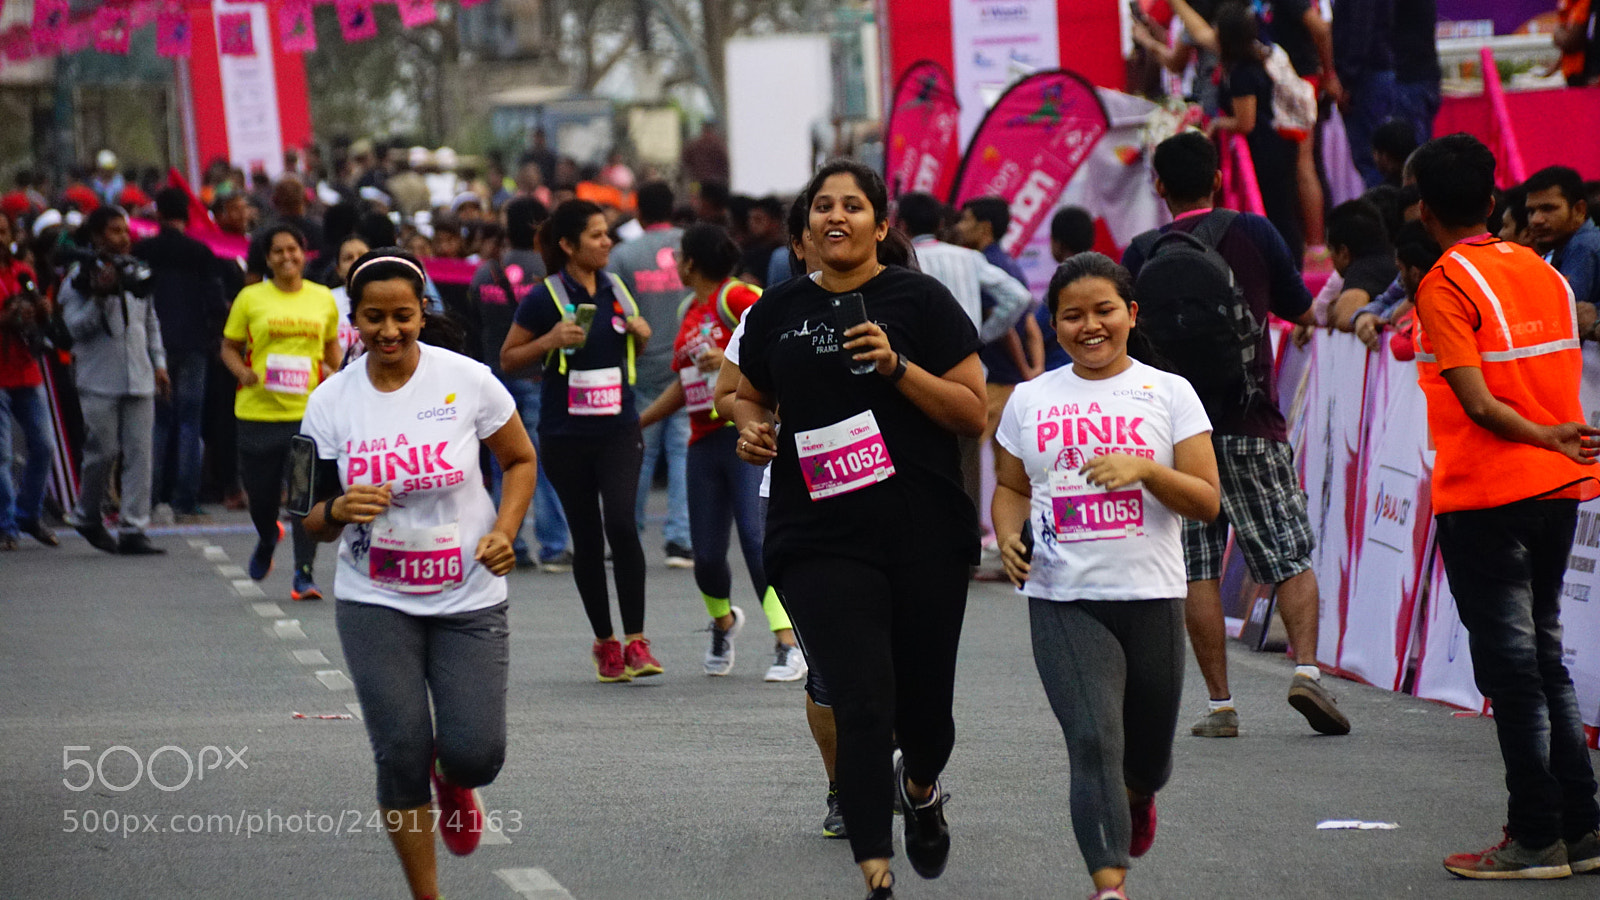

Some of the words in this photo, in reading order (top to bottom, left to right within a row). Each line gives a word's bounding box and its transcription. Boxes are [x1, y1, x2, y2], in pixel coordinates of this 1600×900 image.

[1113, 388, 1154, 399] colors
[417, 407, 457, 420] colors
[1037, 410, 1041, 421] I
[1047, 403, 1080, 418] AM
[1087, 402, 1102, 414] A
[346, 441, 351, 454] I
[357, 438, 387, 453] AM
[395, 433, 409, 446] A
[1037, 416, 1147, 453] PINK
[346, 441, 454, 485] PINK
[824, 443, 887, 480] 11052
[403, 470, 464, 492] SISTER
[1077, 499, 1141, 525] 11053
[396, 556, 459, 579] 11316
